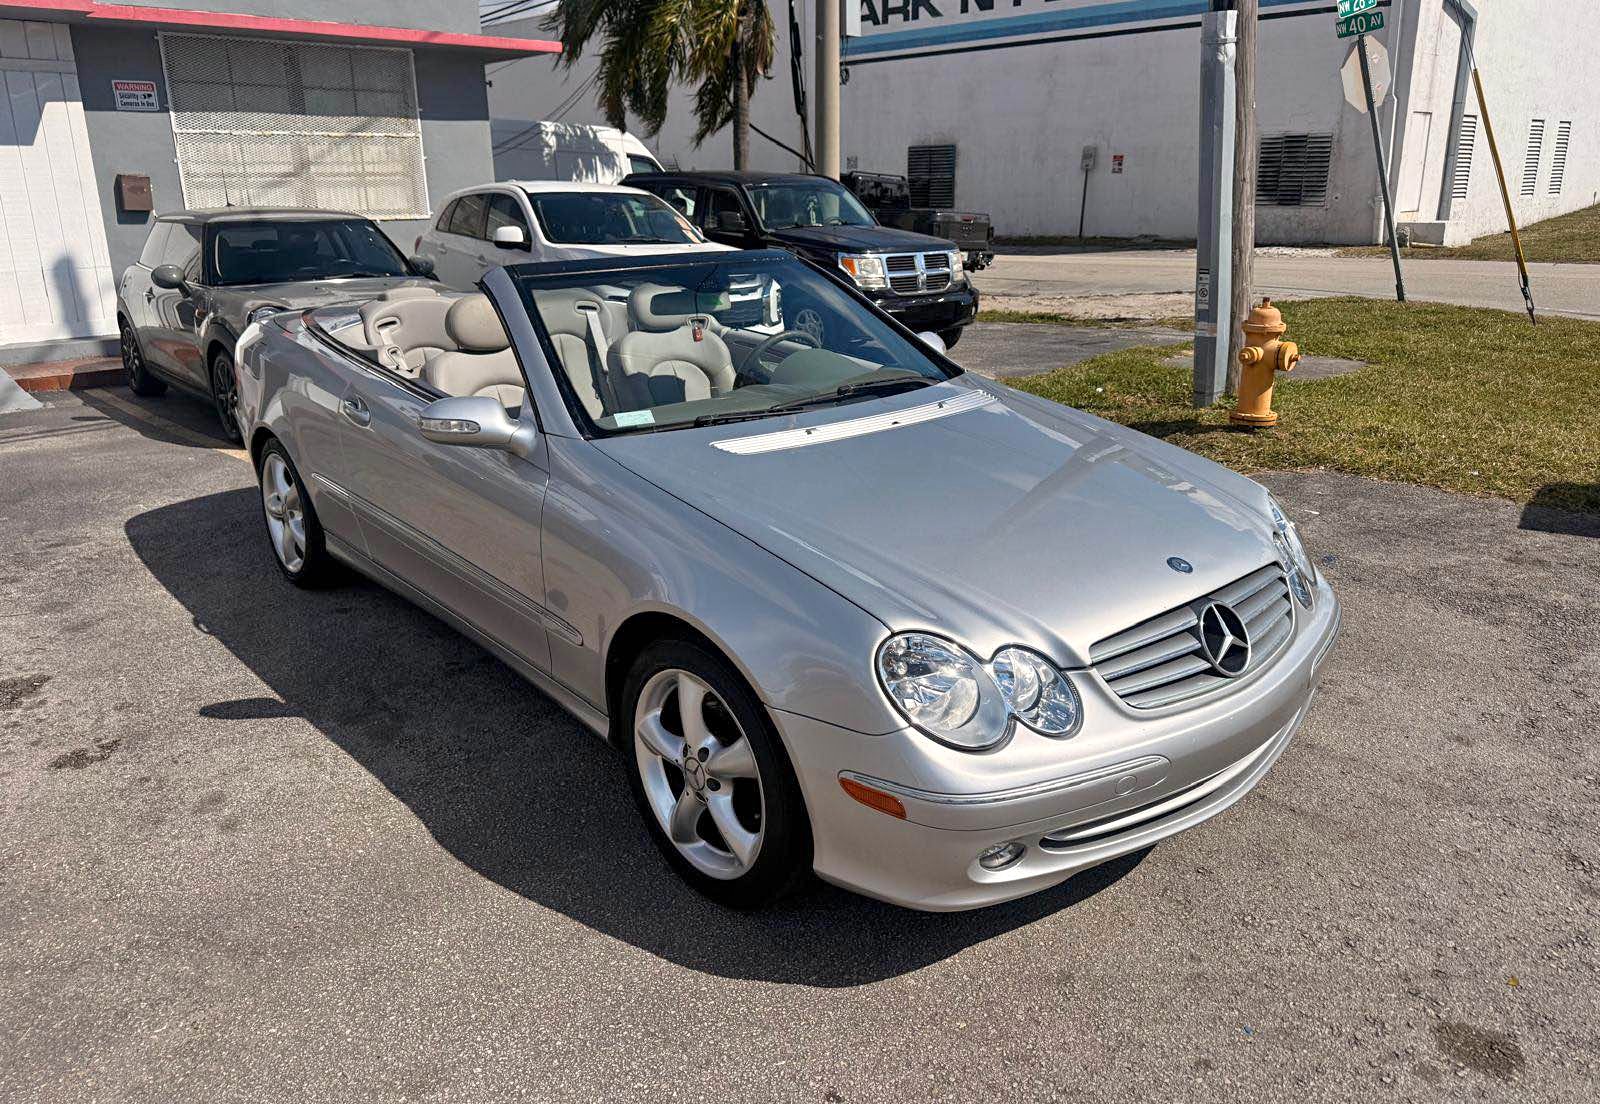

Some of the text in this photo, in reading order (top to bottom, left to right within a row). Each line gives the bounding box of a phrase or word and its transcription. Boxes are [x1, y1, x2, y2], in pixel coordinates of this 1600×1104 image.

[1339, 1, 1350, 13] NW
[1337, 14, 1381, 34] NW 40 AV
[116, 83, 153, 91] WARNING
